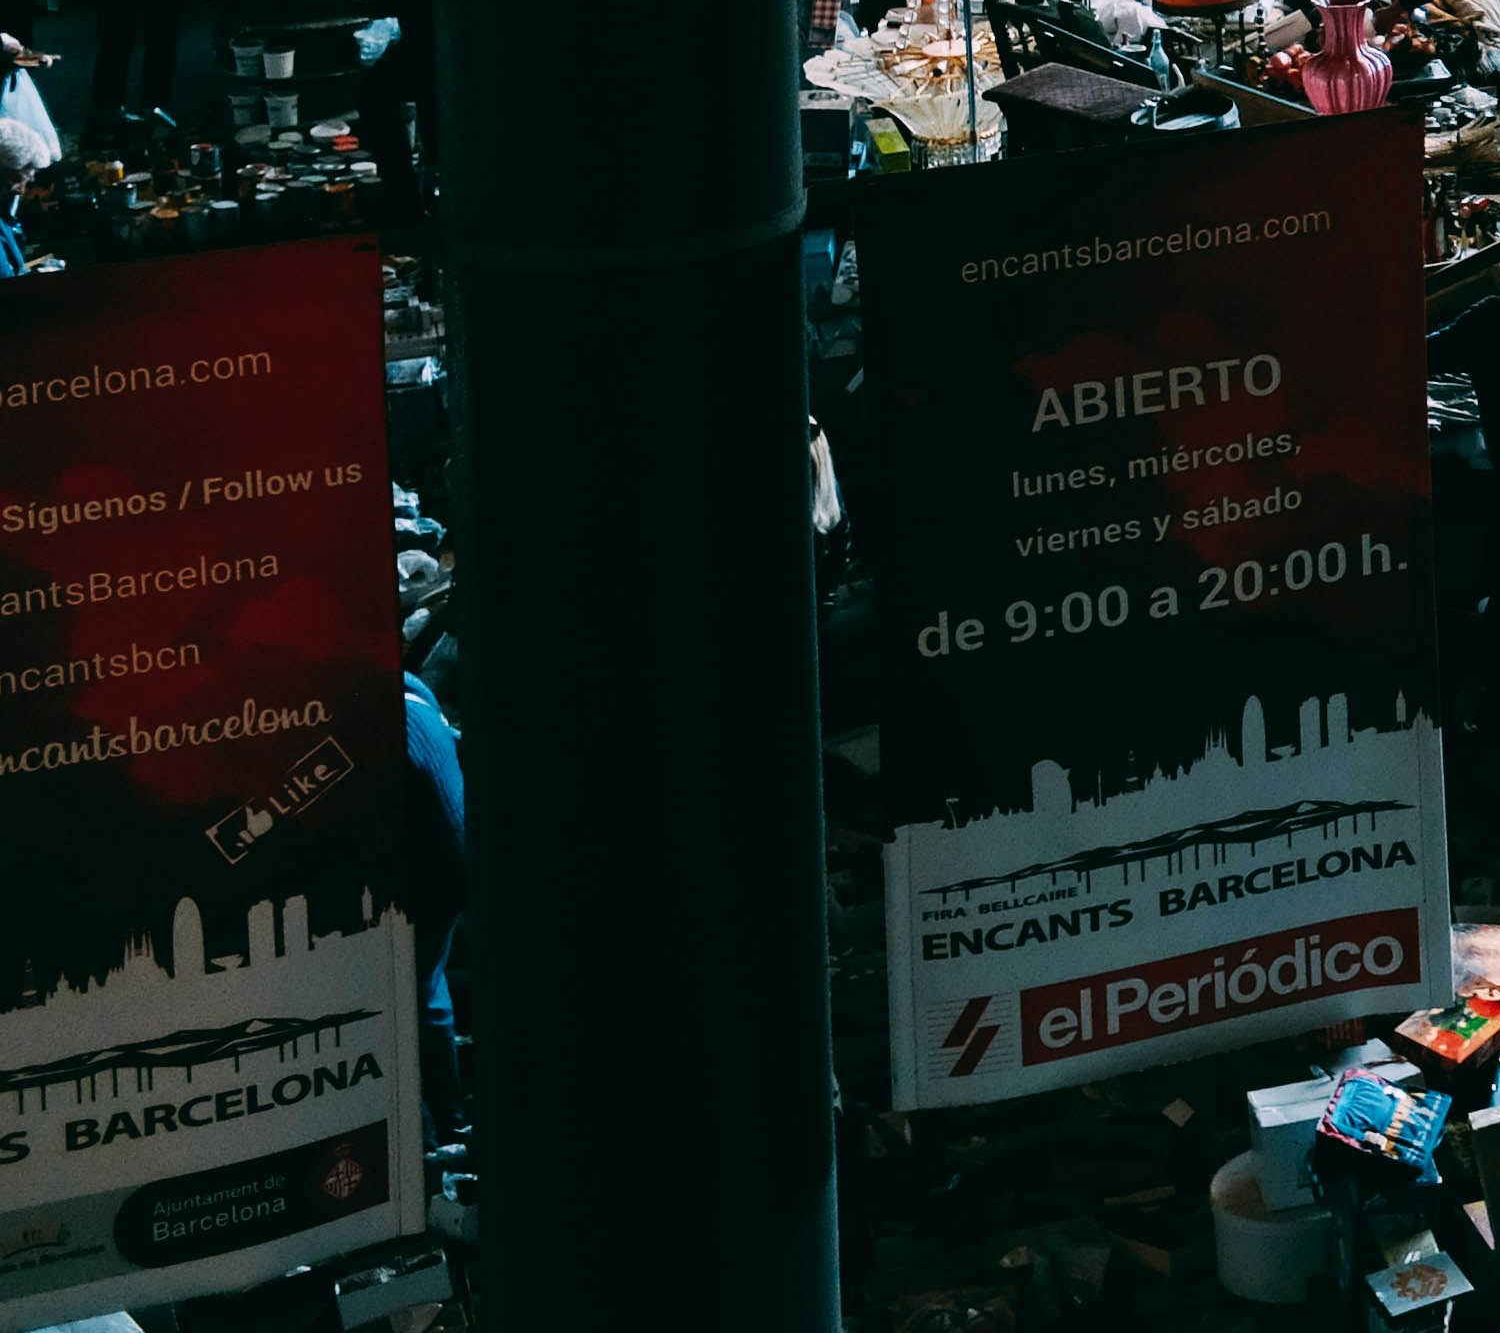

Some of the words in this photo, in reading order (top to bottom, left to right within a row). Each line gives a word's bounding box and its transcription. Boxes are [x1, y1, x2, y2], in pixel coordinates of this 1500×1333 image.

[961, 209, 1331, 284] encantsbarcelona.com
[0, 349, 273, 409] arcelona.com
[1031, 353, 1283, 434] ABIERTO
[1, 488, 168, 535] Síguenos
[202, 467, 314, 506] Follow
[324, 461, 364, 487] us
[1012, 469, 1117, 500] lunes,
[1127, 430, 1303, 481] miércoles,
[1015, 516, 1143, 558] viernes
[1152, 513, 1171, 542] y
[1182, 485, 1303, 530] sábado
[917, 609, 985, 659] de
[1004, 583, 1129, 645] 9:00
[1149, 583, 1180, 620] a
[1198, 539, 1348, 612] 20:00
[1360, 532, 1409, 577] h.
[267, 760, 340, 816] Like
[921, 906, 967, 922] FIRA
[977, 885, 1078, 915] BELLCAIRE
[922, 898, 1133, 961] ENCANTS
[1159, 840, 1417, 918] BARCELONA
[64, 1052, 384, 1153] BARCELONA
[152, 1179, 260, 1219] Ajuntament
[263, 1172, 287, 1192] de
[152, 1196, 288, 1244] Barcelona
